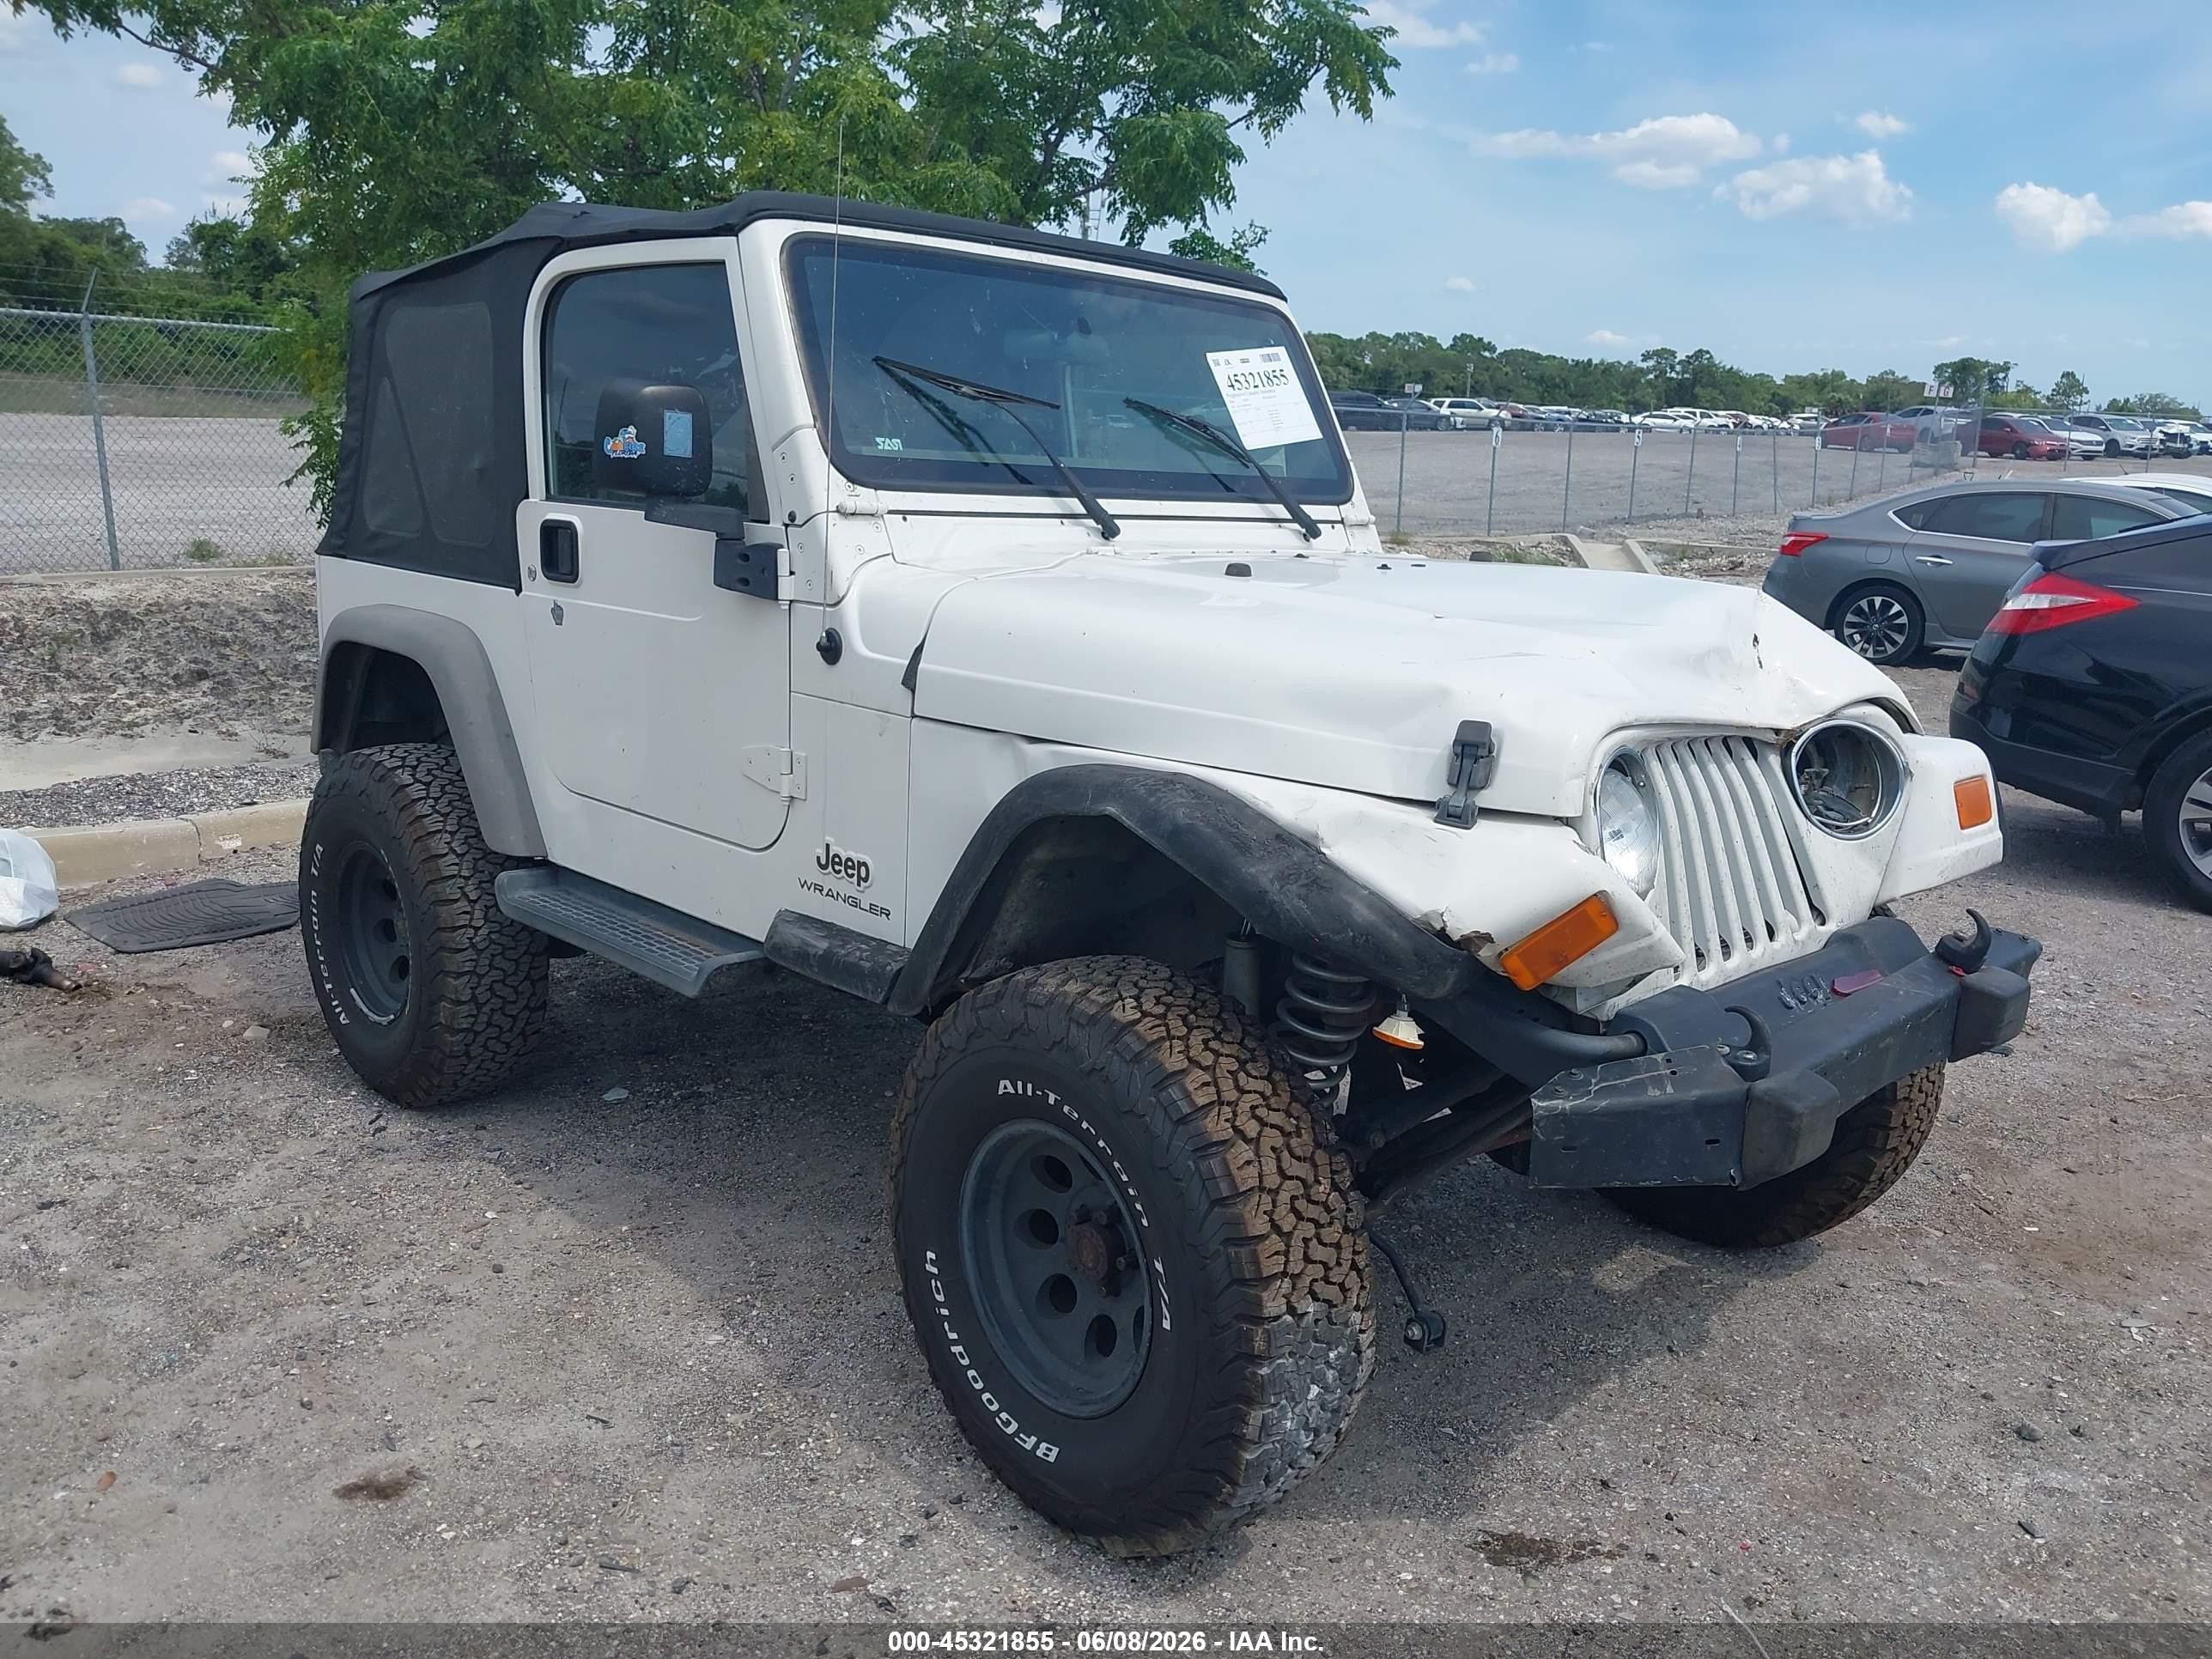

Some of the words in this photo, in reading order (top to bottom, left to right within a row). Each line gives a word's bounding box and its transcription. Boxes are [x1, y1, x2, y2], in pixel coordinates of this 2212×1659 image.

[1227, 368, 1290, 392] 45321855
[310, 842, 324, 878] T/A
[816, 842, 871, 888] Jeep
[797, 877, 891, 921] WRANGLER
[311, 890, 350, 1024] All-Terrain
[998, 1079, 1149, 1228] All-Terrain
[1153, 1256, 1171, 1332] T/A
[925, 1250, 1060, 1463] BFGoodrich
